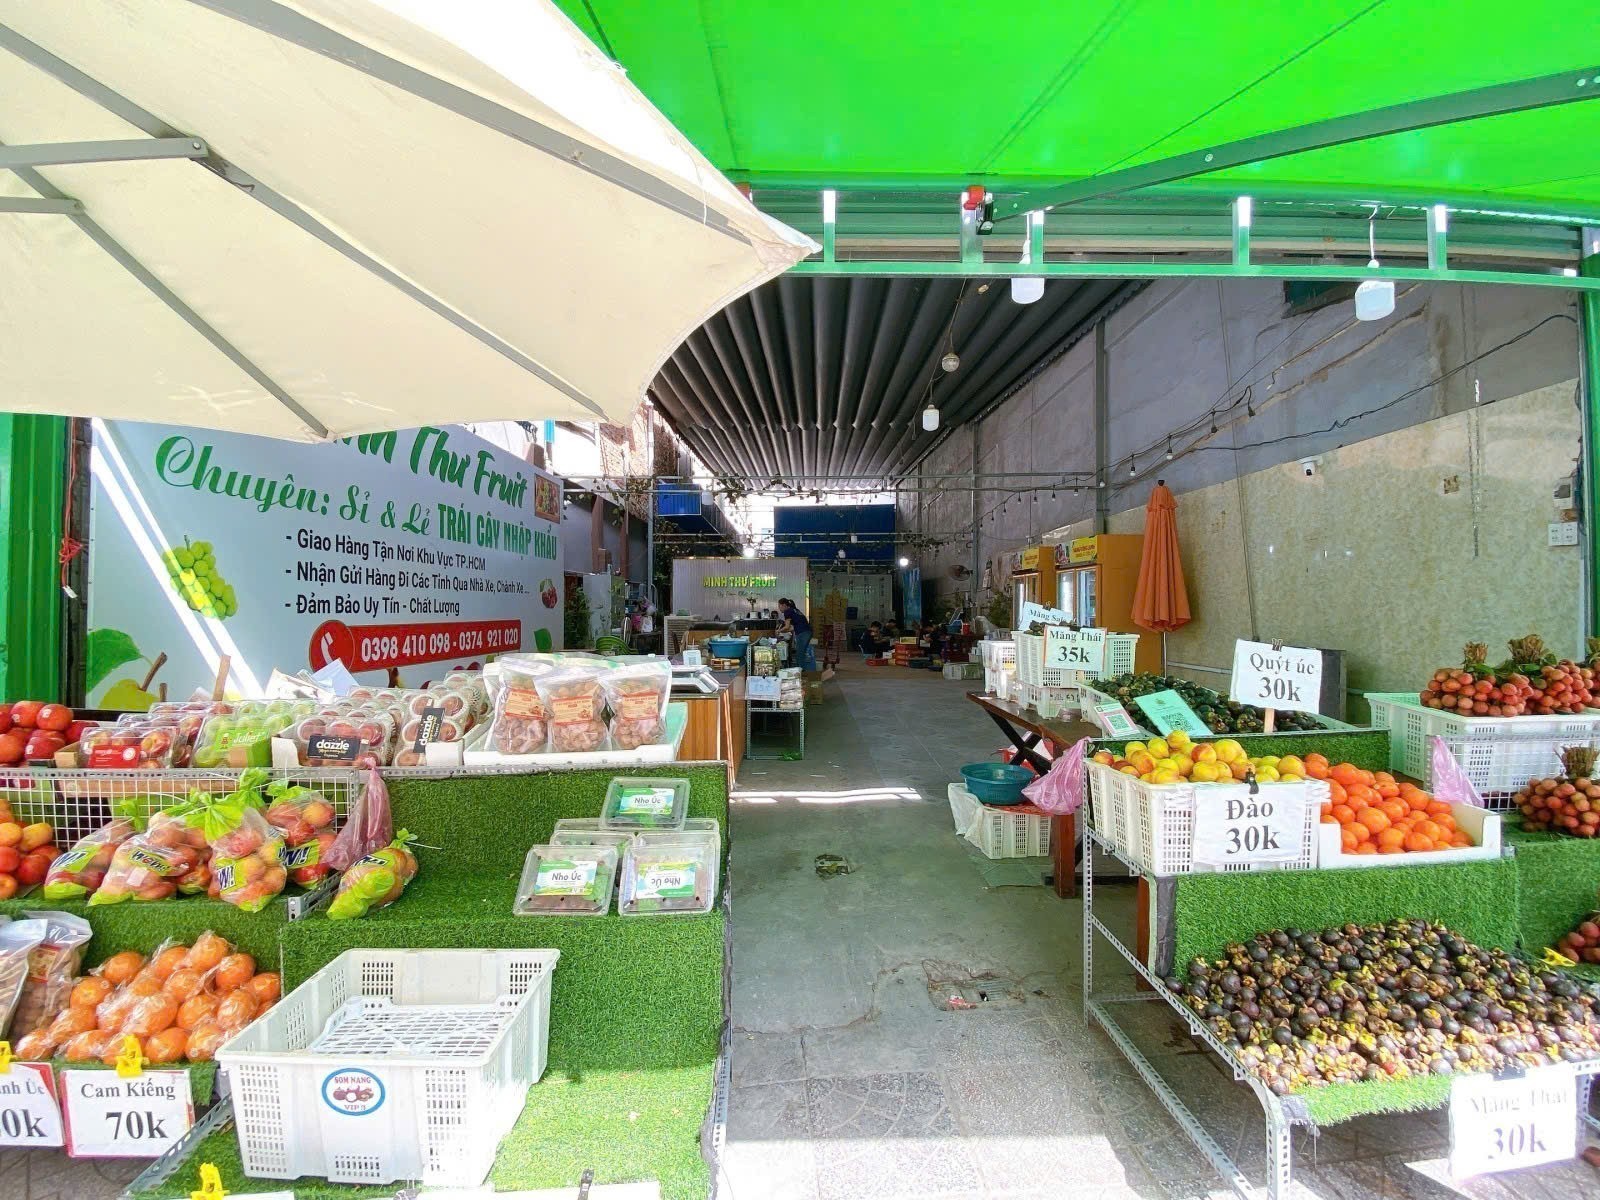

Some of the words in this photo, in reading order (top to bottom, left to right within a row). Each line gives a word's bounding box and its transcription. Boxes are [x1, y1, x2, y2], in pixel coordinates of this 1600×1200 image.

[410, 426, 471, 489] Thư
[474, 450, 528, 509] Fruit
[156, 436, 330, 515] Chuyên:
[339, 485, 371, 524] Sỉ
[380, 500, 395, 529] &
[401, 503, 431, 536] Lẻ
[438, 503, 471, 545] TRÁI
[476, 510, 500, 549] CÂY
[504, 522, 532, 560] NHẬP
[534, 525, 557, 560] KHẨU
[297, 528, 331, 551] Giao
[335, 534, 369, 561] Hàng
[372, 540, 394, 562] Tận
[397, 544, 414, 562] Nơi
[417, 548, 435, 565] Khu
[437, 550, 454, 569] Vực
[455, 553, 486, 571] TP.HCM
[297, 561, 336, 586] Nhận
[340, 564, 362, 584] Gửi
[366, 568, 396, 590] Hàng
[398, 571, 409, 587] Đi
[412, 572, 429, 589] Các
[453, 576, 468, 592] Qua
[470, 578, 484, 592] Nhà
[485, 581, 496, 595] Xe,
[703, 575, 727, 587] MINH
[749, 575, 777, 587] FRUIT
[296, 592, 331, 614] Đảm
[335, 593, 360, 614] Bảo
[364, 596, 379, 618] Uy
[382, 595, 400, 614] Tín
[409, 597, 432, 614] Chất
[434, 599, 460, 617] Lượng
[361, 636, 398, 662] 0398
[402, 634, 426, 657] 410
[430, 632, 450, 654] 098
[459, 630, 483, 651] 0374
[487, 629, 502, 647] 921
[504, 627, 519, 645] 020
[1050, 630, 1077, 643] Măng
[1081, 631, 1102, 642] Thái
[1058, 646, 1090, 663] 35k
[1250, 652, 1291, 675] Quýt
[1297, 658, 1315, 675] úc
[1258, 676, 1301, 702] 30k
[419, 715, 434, 745] dazzle
[316, 738, 350, 751] dazzle
[651, 794, 661, 804] Úc
[1225, 797, 1274, 820] Đào
[1226, 825, 1281, 854] 30k
[551, 873, 569, 881] Nho
[571, 870, 582, 881] Úc
[651, 878, 662, 888] Úc
[663, 877, 681, 885] Nho
[0, 1081, 21, 1096] nh
[25, 1078, 46, 1095] Úc
[81, 1083, 121, 1099] Cam
[126, 1077, 176, 1100] Kiếng
[350, 1076, 372, 1084] NANG
[0, 1108, 48, 1138] 0k
[105, 1110, 169, 1140] 70k
[1488, 1122, 1547, 1159] 30k
